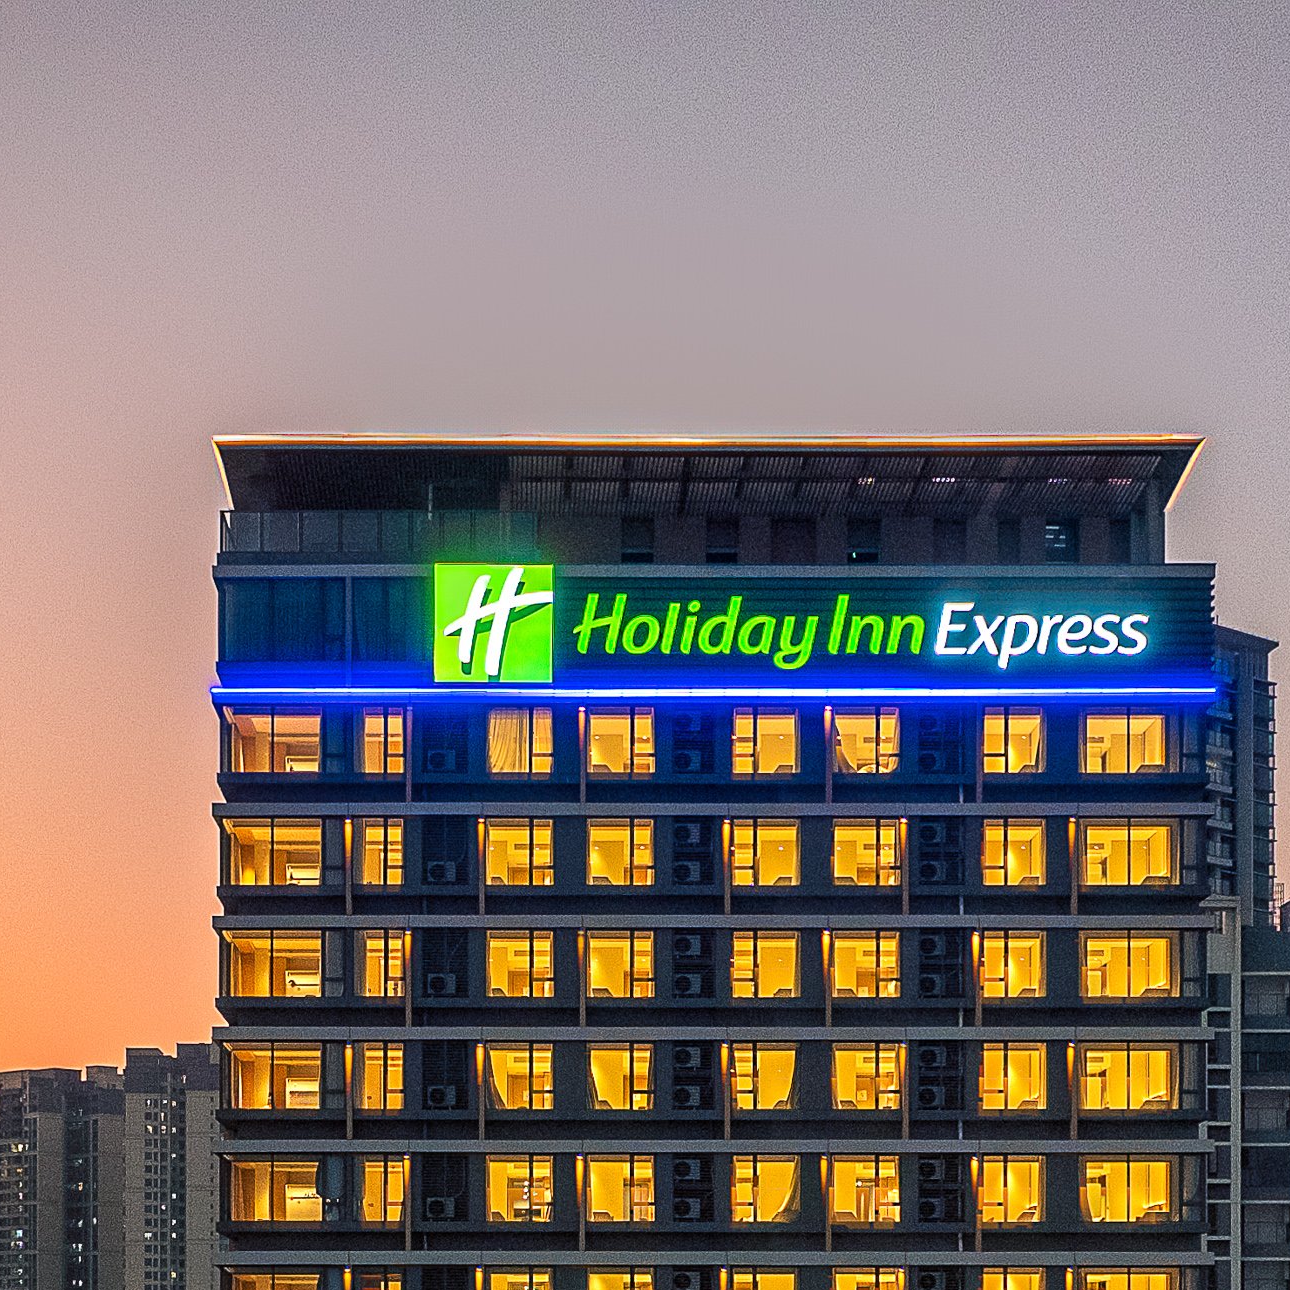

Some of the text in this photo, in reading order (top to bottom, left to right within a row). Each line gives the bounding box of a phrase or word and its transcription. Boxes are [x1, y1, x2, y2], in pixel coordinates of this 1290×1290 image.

[573, 593, 1150, 670] Holiday Inn Express
